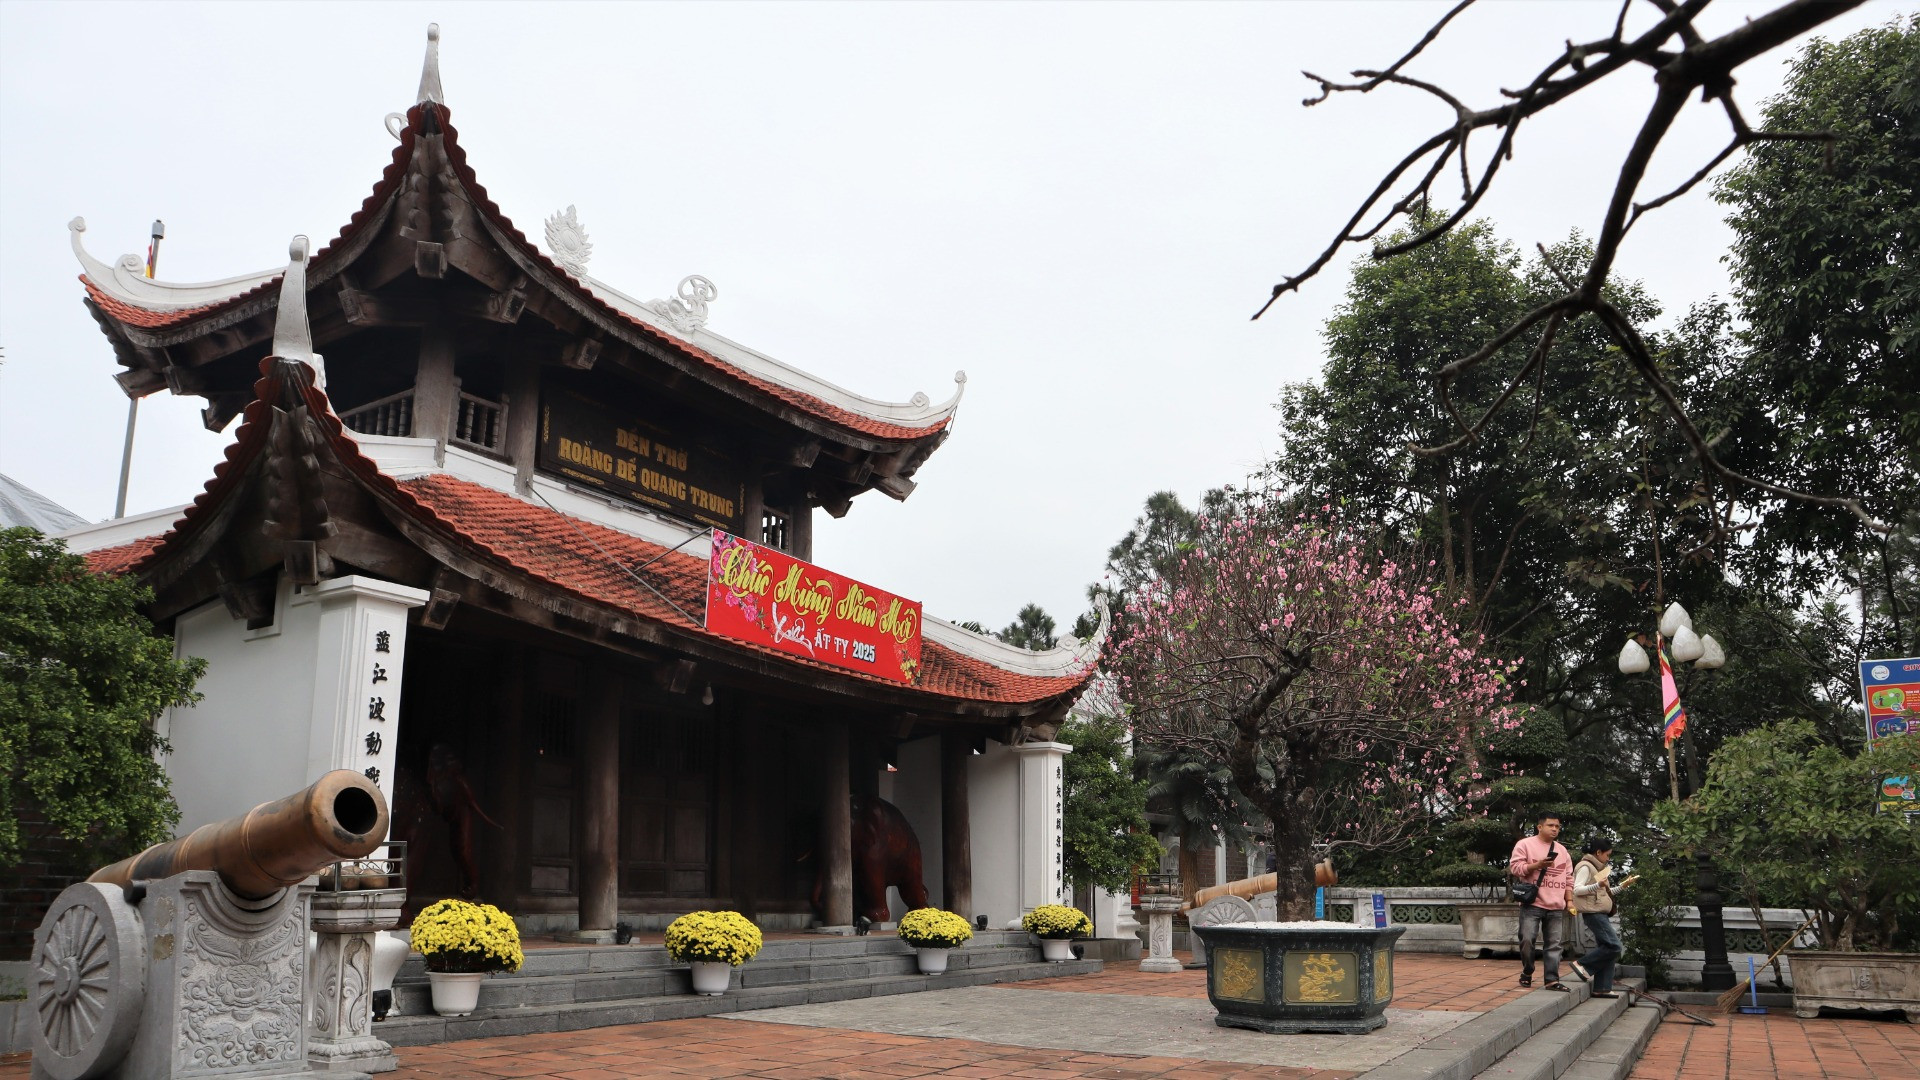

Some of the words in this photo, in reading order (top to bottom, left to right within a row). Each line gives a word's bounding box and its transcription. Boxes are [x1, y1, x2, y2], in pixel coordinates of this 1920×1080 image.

[558, 437, 613, 474] HOÀNG
[616, 457, 637, 484] ĐẾ
[641, 468, 686, 500] QUANG
[690, 485, 734, 518] TRUNG
[719, 545, 774, 597] Chúc
[774, 563, 833, 625] Mừng
[836, 583, 878, 628] Năm
[879, 598, 918, 644] Mới
[814, 628, 831, 651] ẤT
[852, 639, 876, 663] 2025
